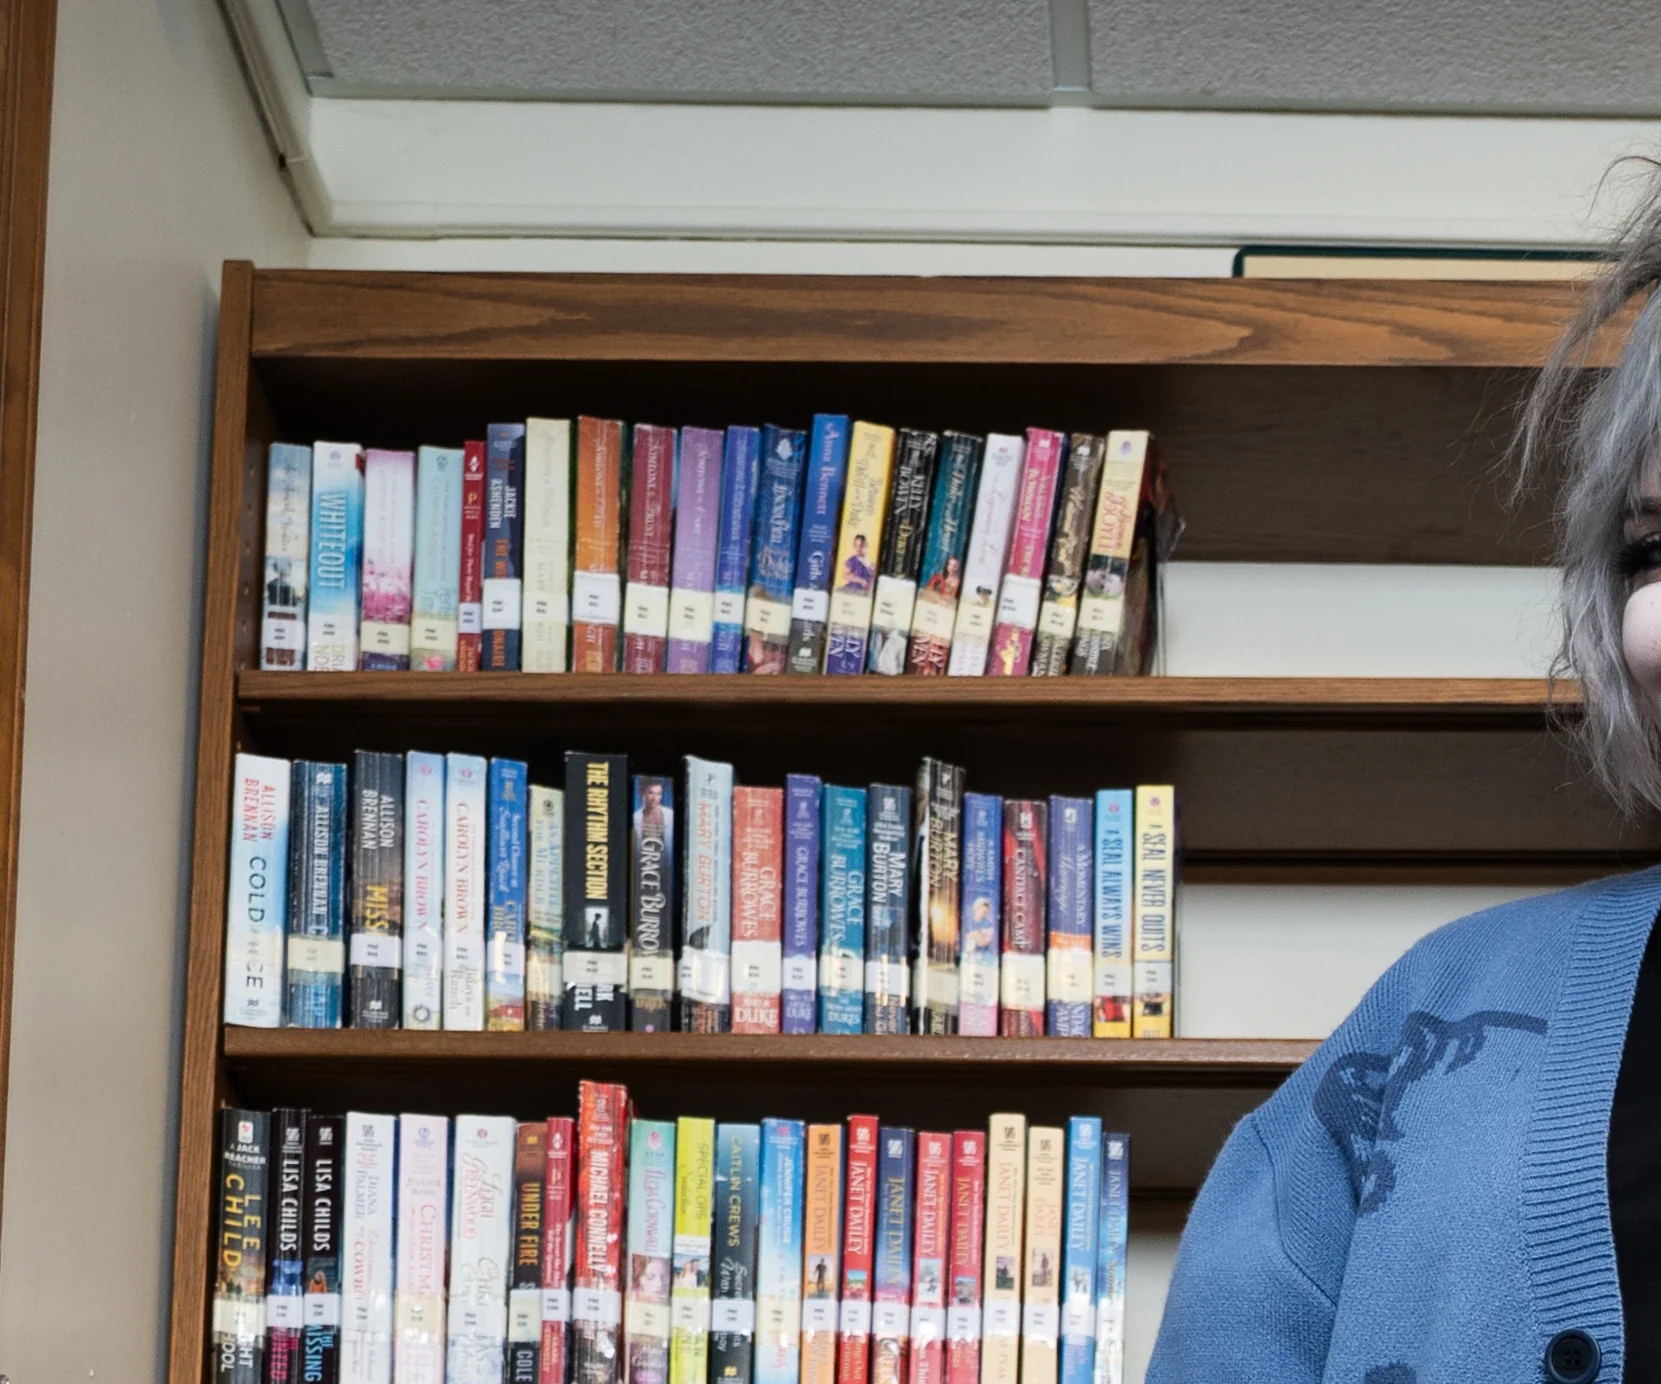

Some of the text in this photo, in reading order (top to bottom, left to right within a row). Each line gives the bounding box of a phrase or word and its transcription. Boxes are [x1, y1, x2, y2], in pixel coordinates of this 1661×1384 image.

[489, 479, 502, 528] ASHENDEN
[504, 486, 516, 518] JACKIE
[815, 423, 841, 514] Anna Bennett
[894, 466, 913, 514] BOWEN
[908, 474, 926, 511] KELLY
[317, 492, 347, 590] WHITEOUT
[242, 778, 260, 841] BRENNAN
[260, 785, 276, 840] ALLISON
[361, 789, 379, 849] BRENNAN
[379, 795, 395, 848] ALLISON
[585, 762, 609, 899] THE RHYTHM SECTION
[247, 856, 267, 923] COLD
[456, 803, 469, 933] CAROLYN BROWN
[740, 851, 758, 937] BURROWES
[760, 866, 777, 921] GRACE
[1101, 838, 1122, 957] SEAL ALWAYS WINS
[1140, 833, 1166, 952] SEAL NEVER QUITS
[223, 1174, 243, 1267] CHILD
[243, 1194, 261, 1250] LEE
[313, 1159, 332, 1251] LISA CHILDS
[519, 1182, 540, 1266] UNDER FIRE
[587, 1150, 608, 1271] MICHAEL CONNELLY
[728, 1134, 742, 1247] CAITLIN CREWS
[848, 1162, 869, 1255] JANET DAILEY
[516, 1350, 533, 1382] COLE
